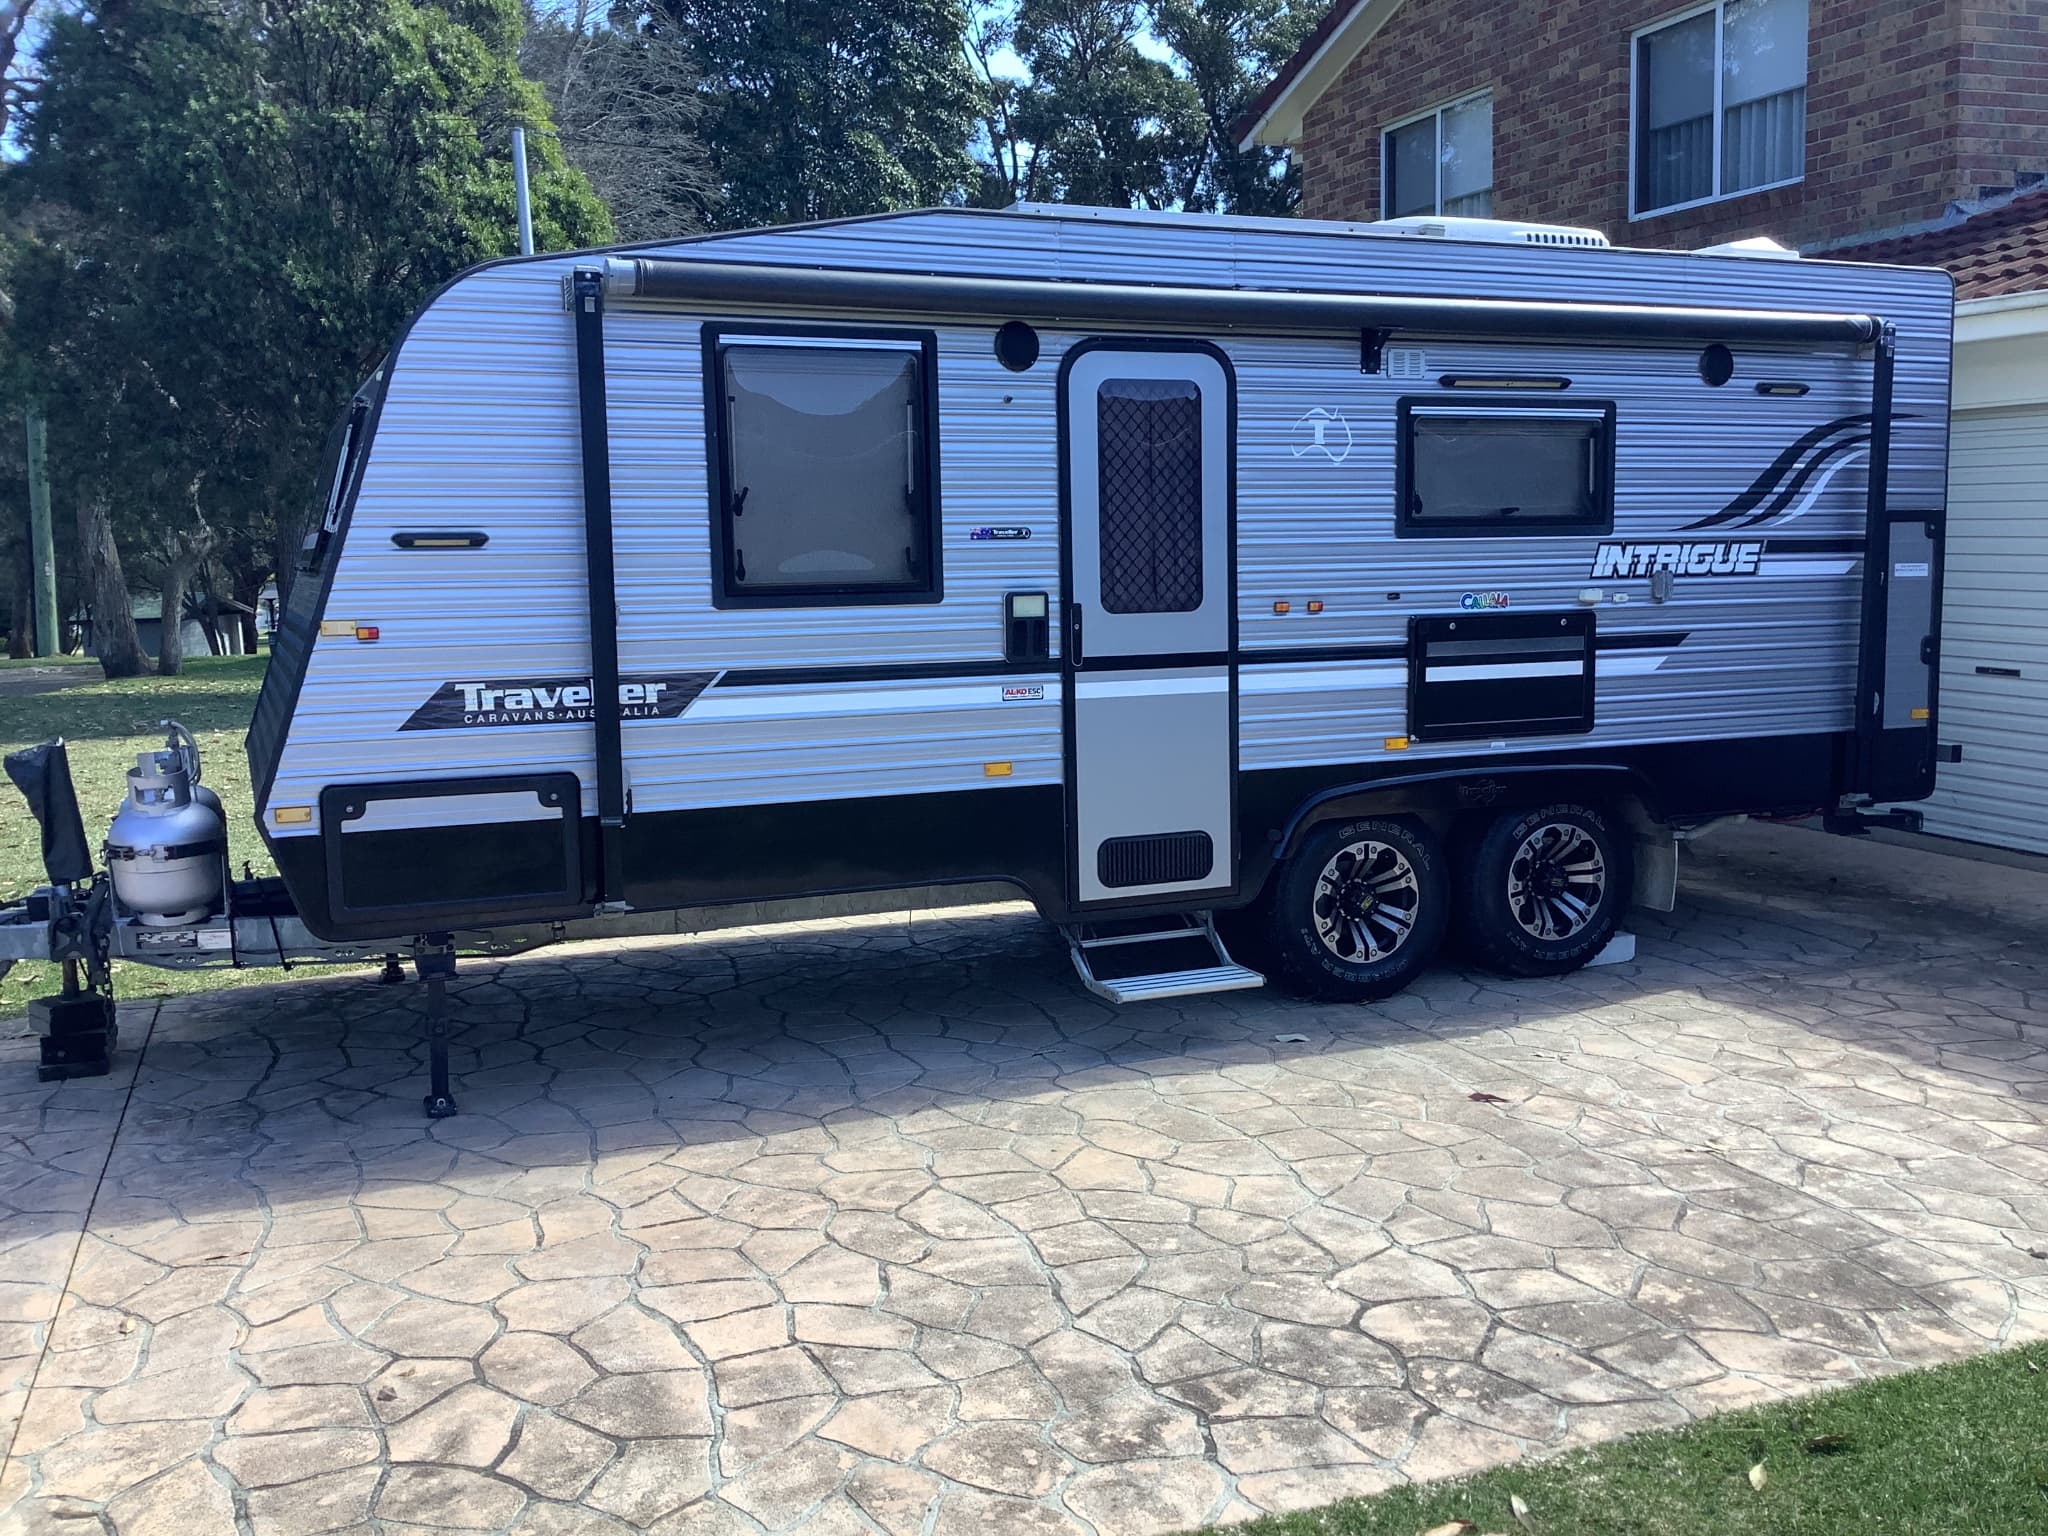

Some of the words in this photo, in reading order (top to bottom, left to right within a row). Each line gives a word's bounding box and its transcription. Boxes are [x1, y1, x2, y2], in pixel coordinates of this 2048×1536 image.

[1591, 541, 1763, 578] INTRIGUE
[454, 679, 667, 712] Traveer
[1028, 687, 1041, 695] ESC
[464, 710, 556, 724] CARAVANS
[566, 706, 660, 720] AUSALIA
[1338, 820, 1431, 871] GENERAL
